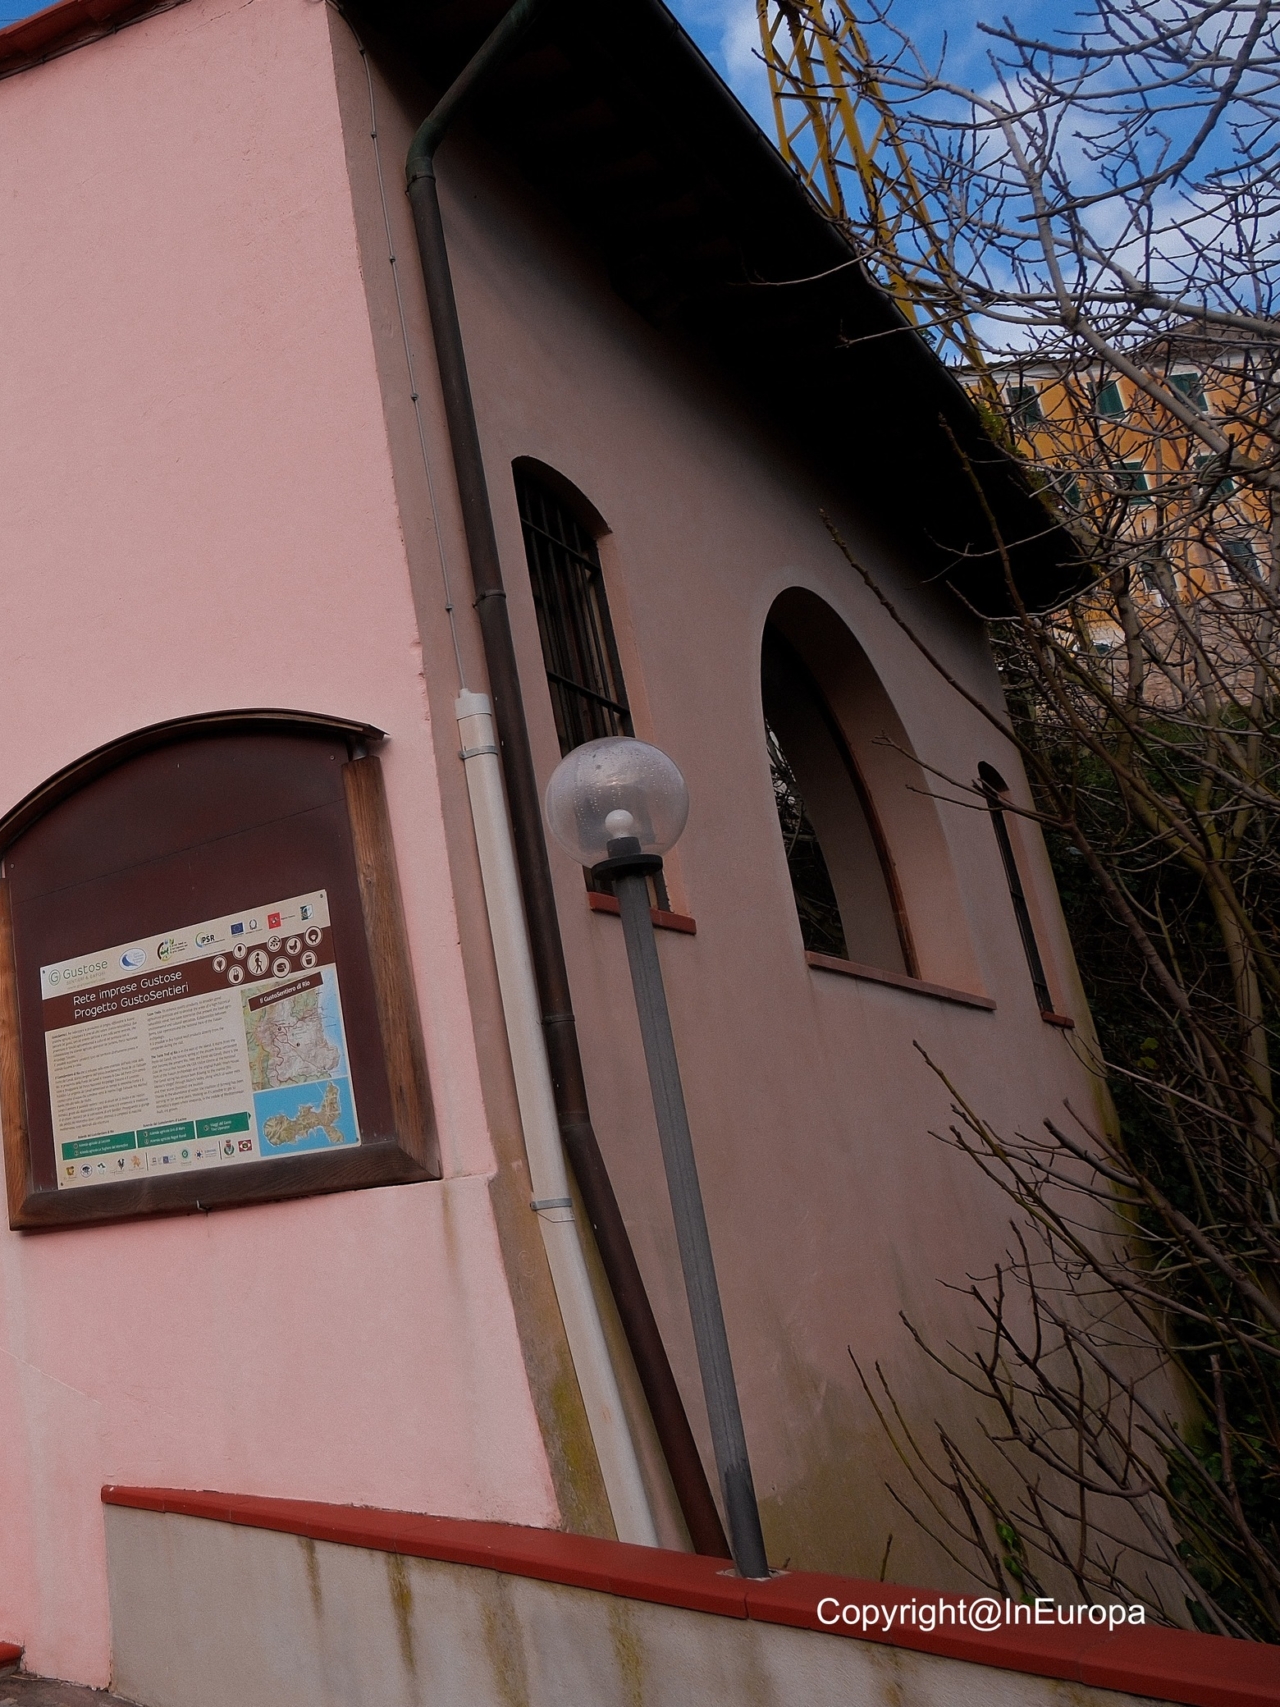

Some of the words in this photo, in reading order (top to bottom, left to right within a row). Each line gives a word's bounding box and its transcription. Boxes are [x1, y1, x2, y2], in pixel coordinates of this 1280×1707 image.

[201, 934, 215, 943] PSR
[63, 960, 108, 979] Gustose
[73, 991, 96, 1005] Rete
[98, 980, 137, 1000] imprese
[140, 969, 182, 988] Gustose
[263, 986, 296, 1001] GustoSentiero
[74, 999, 117, 1019] Progetto
[120, 982, 188, 1007] GustoSentieri
